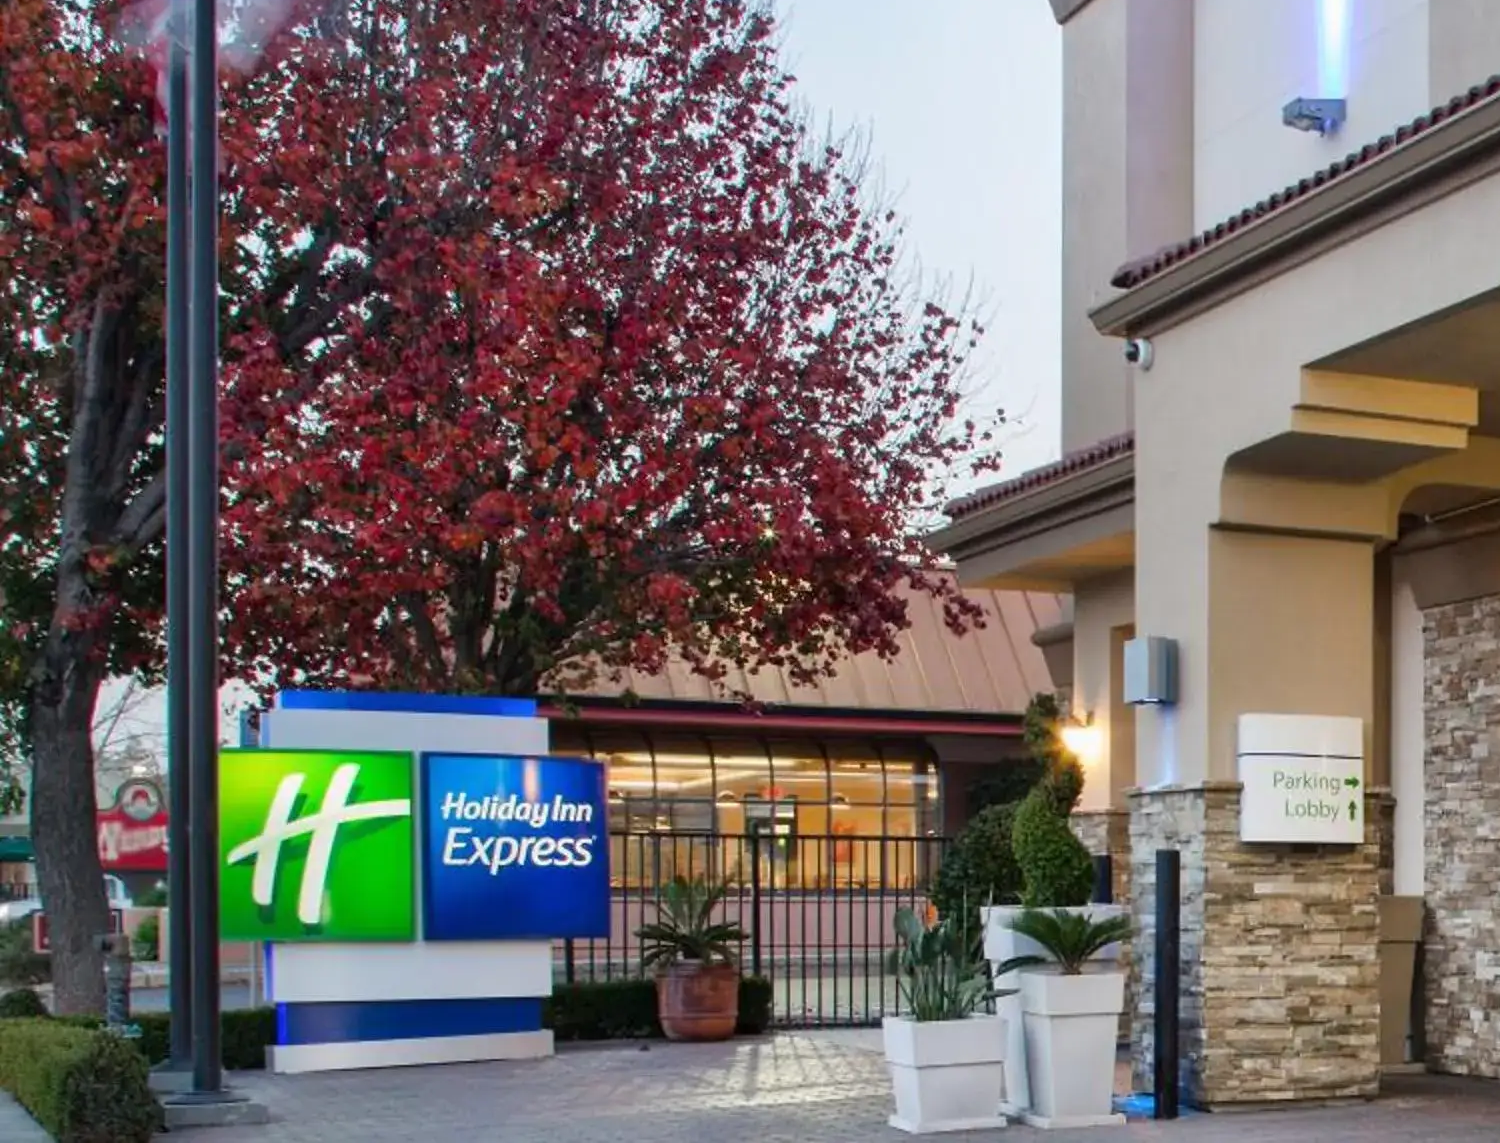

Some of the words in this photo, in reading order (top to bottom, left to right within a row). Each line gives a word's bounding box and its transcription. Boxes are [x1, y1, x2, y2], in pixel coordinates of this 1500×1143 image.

[1273, 770, 1341, 796] Parking
[440, 792, 549, 828] Holiday
[551, 794, 593, 822] Inn
[1285, 798, 1340, 822] Lobby
[442, 826, 594, 876] Express
